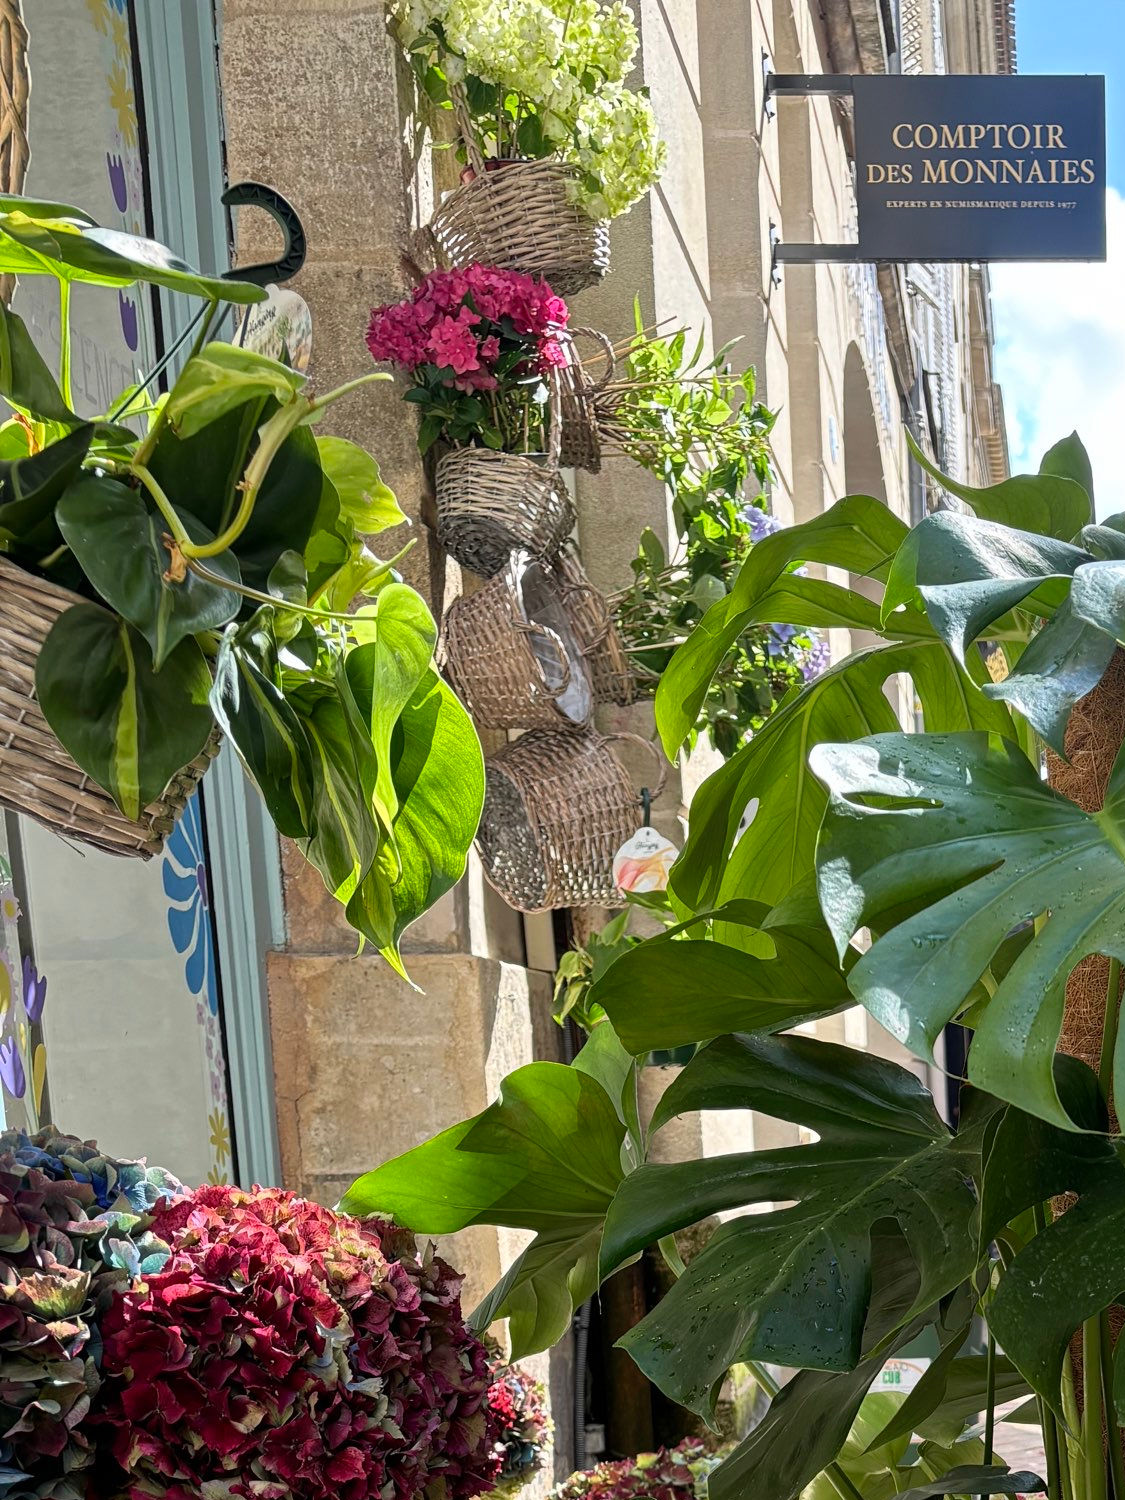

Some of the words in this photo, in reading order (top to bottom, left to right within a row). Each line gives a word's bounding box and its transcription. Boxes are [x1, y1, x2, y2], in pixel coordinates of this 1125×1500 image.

[891, 123, 1068, 150] COMPTOIR
[866, 163, 914, 185] DES
[920, 158, 1096, 185] MONNAIES
[886, 200, 928, 209] EXPERTS
[929, 200, 943, 209] EN
[945, 200, 1018, 210] NUMISMATIQUE
[1020, 200, 1055, 209] DEPUIS
[1057, 201, 1078, 209] 1977
